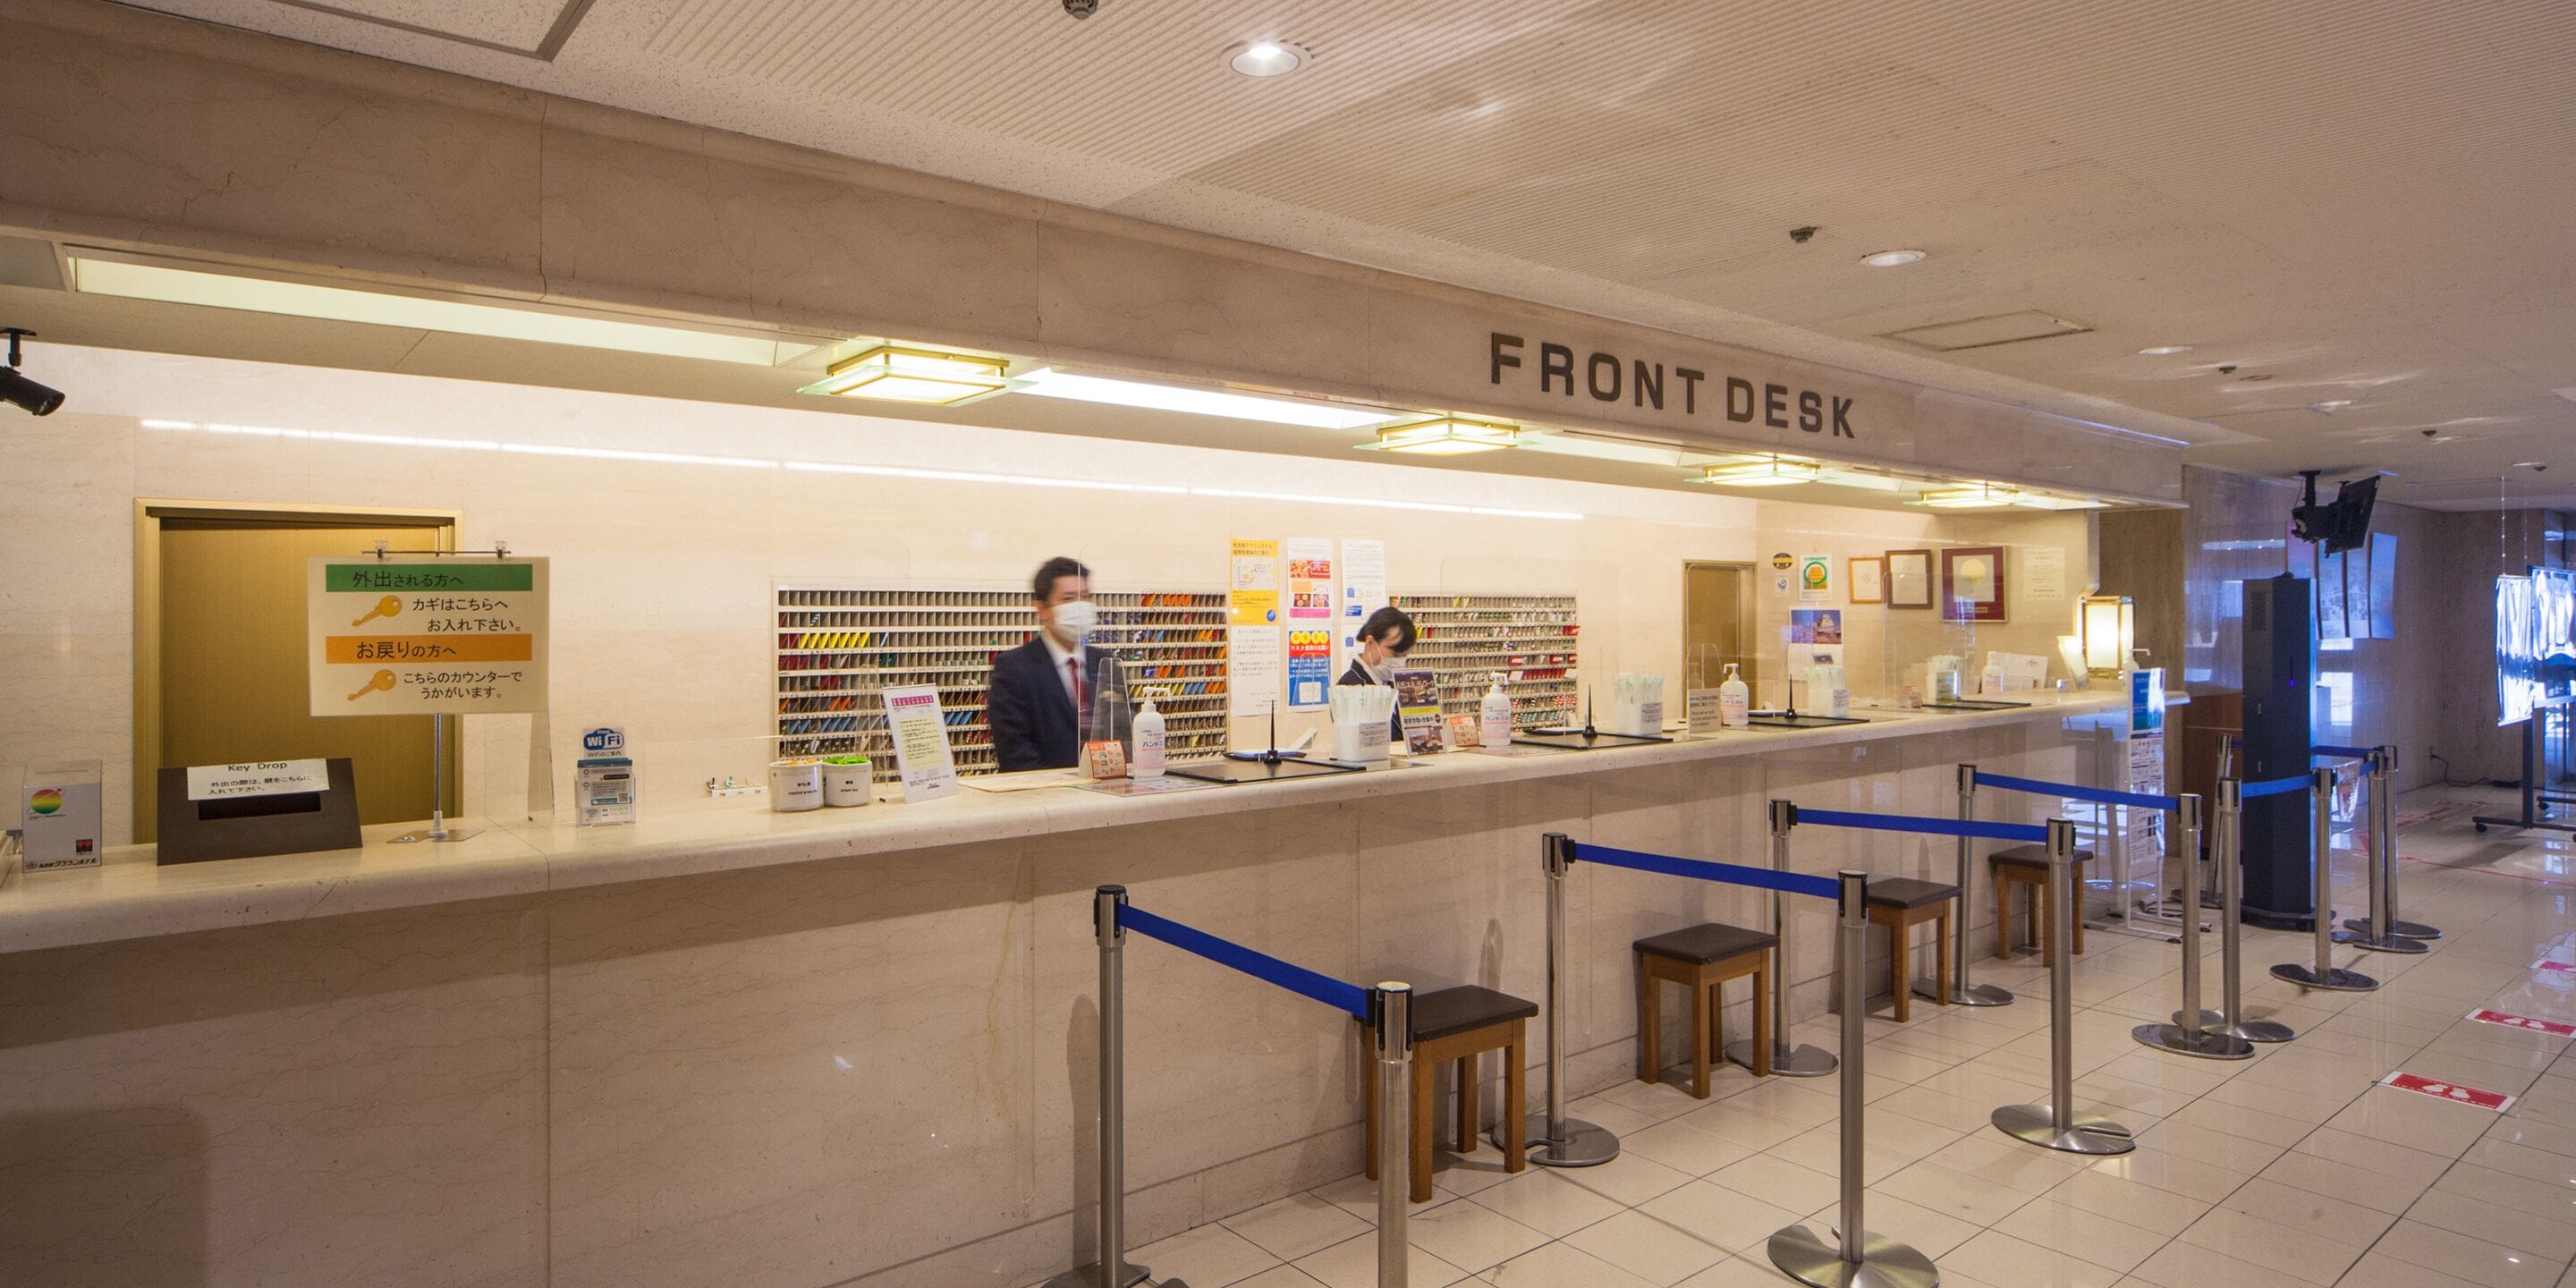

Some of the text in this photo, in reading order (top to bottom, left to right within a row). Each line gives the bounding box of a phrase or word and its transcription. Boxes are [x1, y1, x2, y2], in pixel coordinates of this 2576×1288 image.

[1491, 332, 1855, 439] FRONT DESK
[352, 571, 464, 588] 外出される方へ
[412, 597, 508, 612] カギはこちらへ
[428, 618, 521, 631] お入れ下さい。
[357, 641, 456, 659] お戻りの方へ
[403, 671, 522, 683] こちらのカウンターで
[421, 687, 502, 699] うかがいます。
[228, 762, 287, 773] Key Drop
[211, 775, 311, 788] 外出の際は、鍵をこちらに
[208, 785, 266, 795] 入れて下さい。
